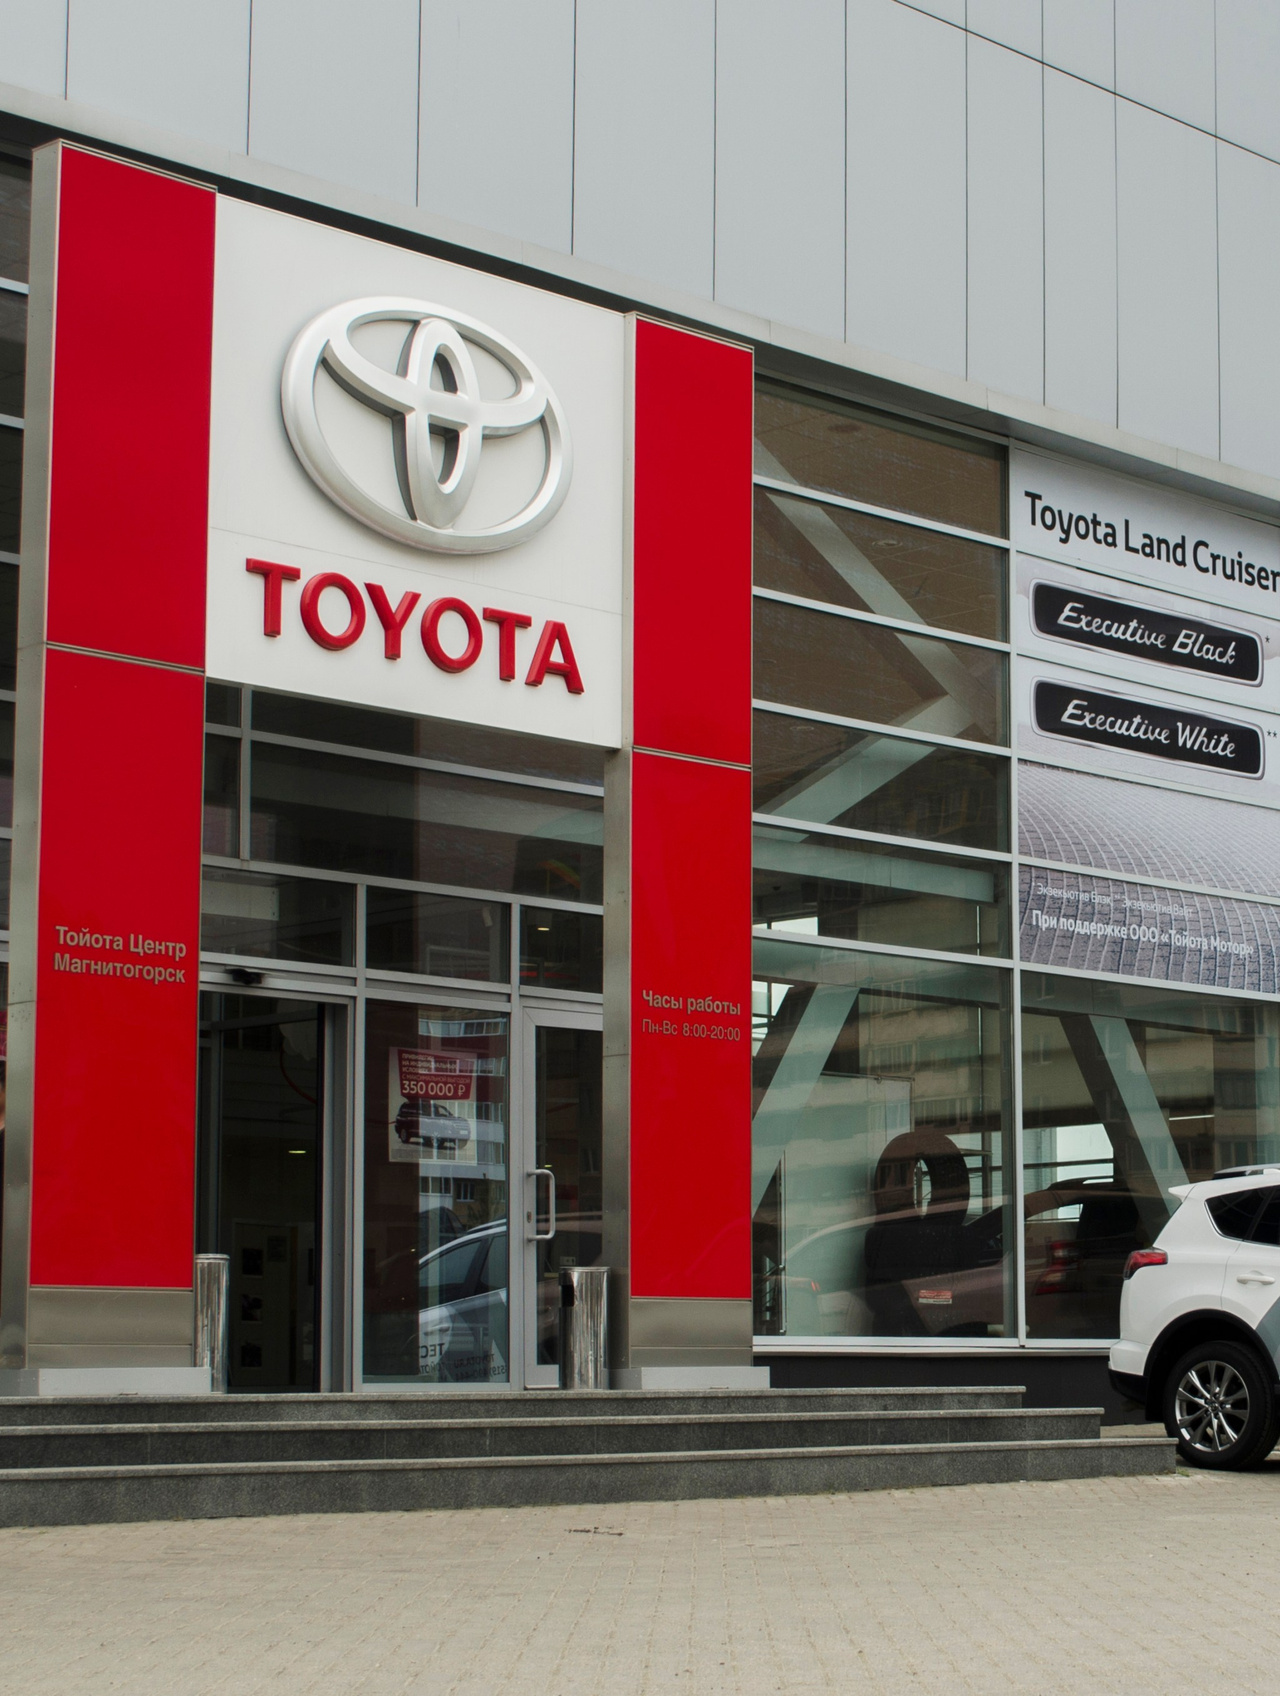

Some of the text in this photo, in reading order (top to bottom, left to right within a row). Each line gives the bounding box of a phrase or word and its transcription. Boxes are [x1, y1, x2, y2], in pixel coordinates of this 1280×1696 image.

[1024, 490, 1118, 548] Toyota
[1124, 518, 1187, 568] Land
[1192, 540, 1280, 592] Cruiser
[246, 557, 584, 694] TOYOTA
[1057, 602, 1236, 665] Executive Black
[1061, 699, 1236, 758] Executive White
[55, 925, 187, 962] Тойота Центр
[1032, 910, 1254, 960] При поддержке ООО «Тойота Мотор»
[54, 952, 186, 985] Магнитогорск
[642, 989, 741, 1015] Часы работы
[642, 1018, 741, 1041] Пн-Вс 8:00-20:00
[402, 1081, 426, 1094] 350
